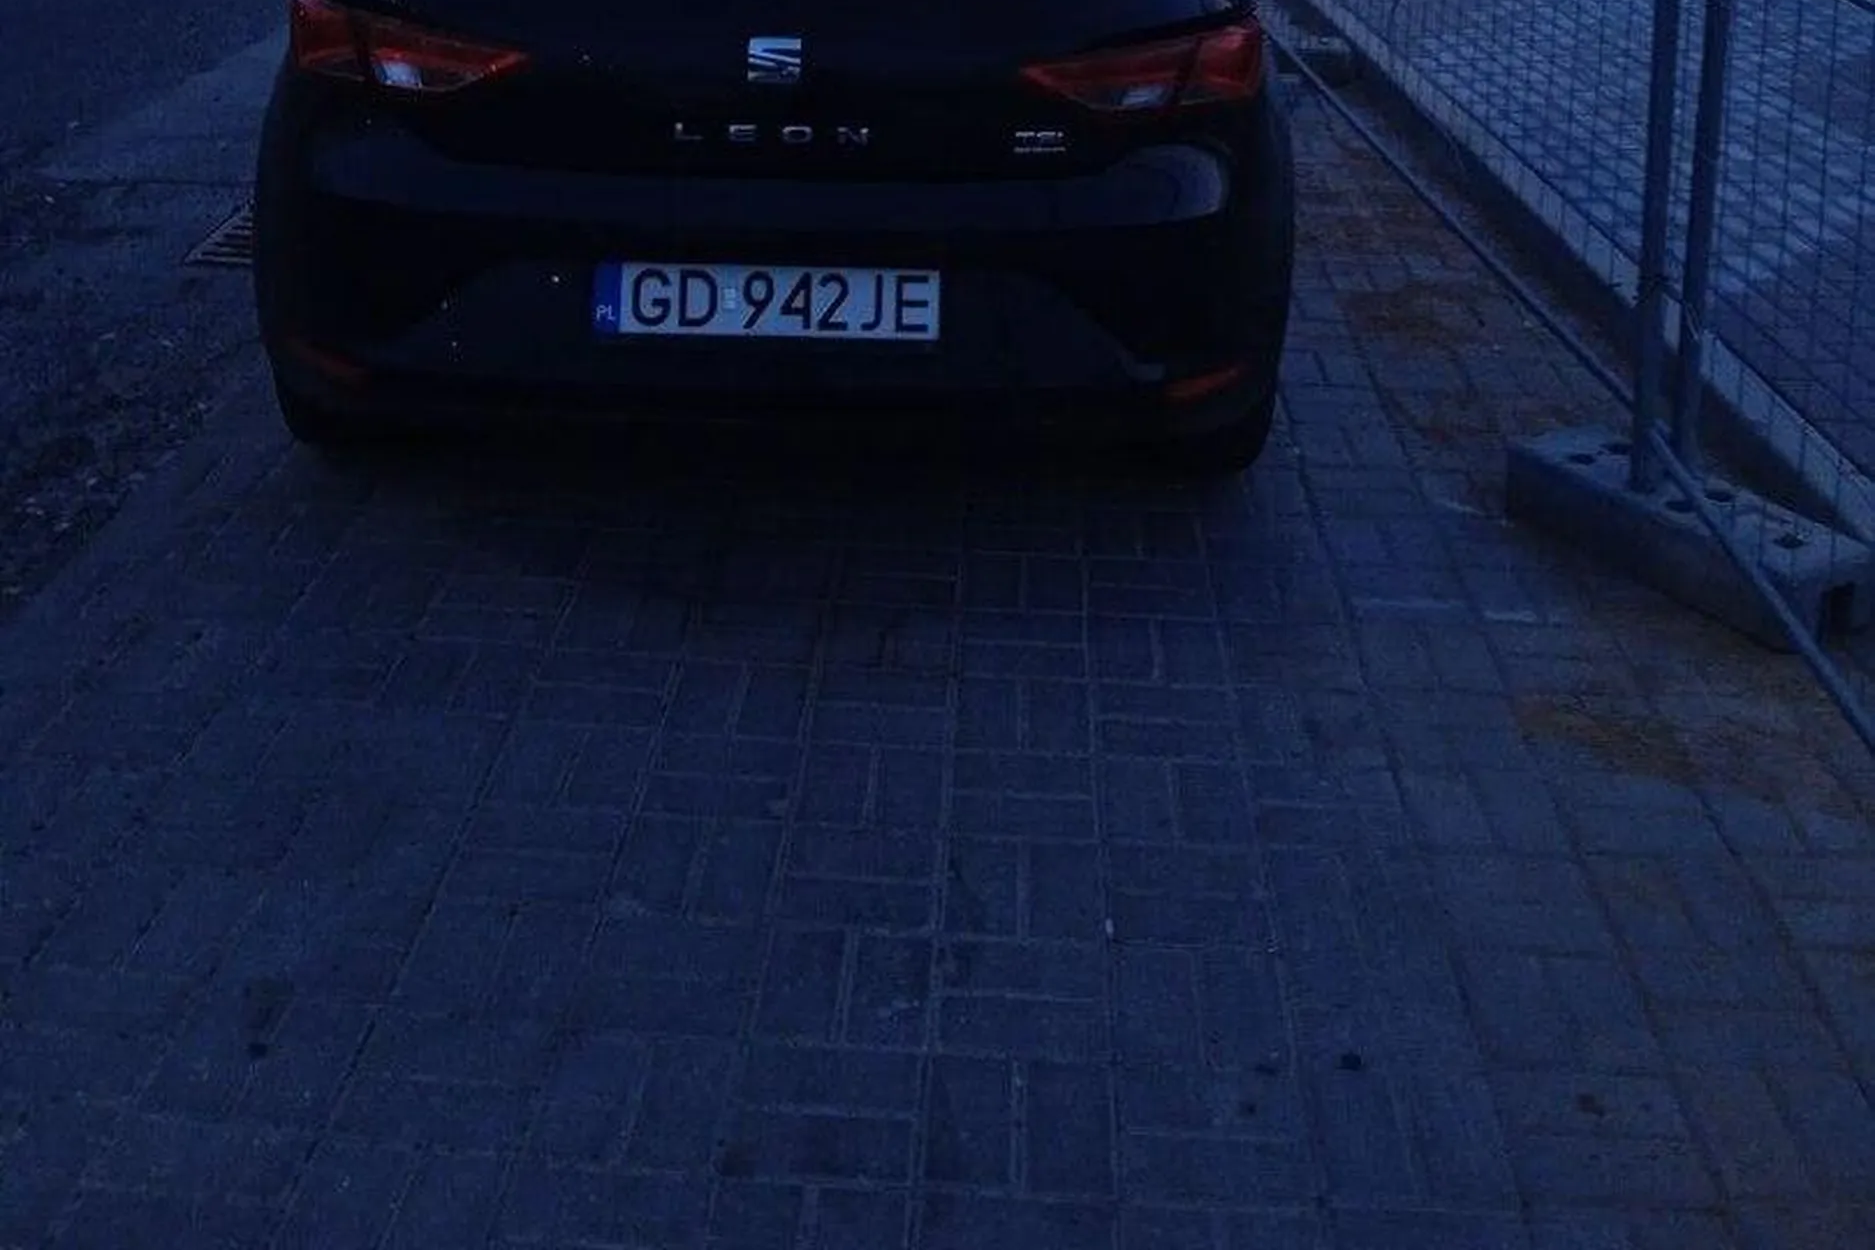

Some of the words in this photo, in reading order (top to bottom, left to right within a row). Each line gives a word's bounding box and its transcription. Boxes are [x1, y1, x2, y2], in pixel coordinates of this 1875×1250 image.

[673, 121, 870, 144] LEON
[632, 268, 720, 327] GD
[742, 271, 930, 332] 942JE
[595, 303, 617, 322] PL
